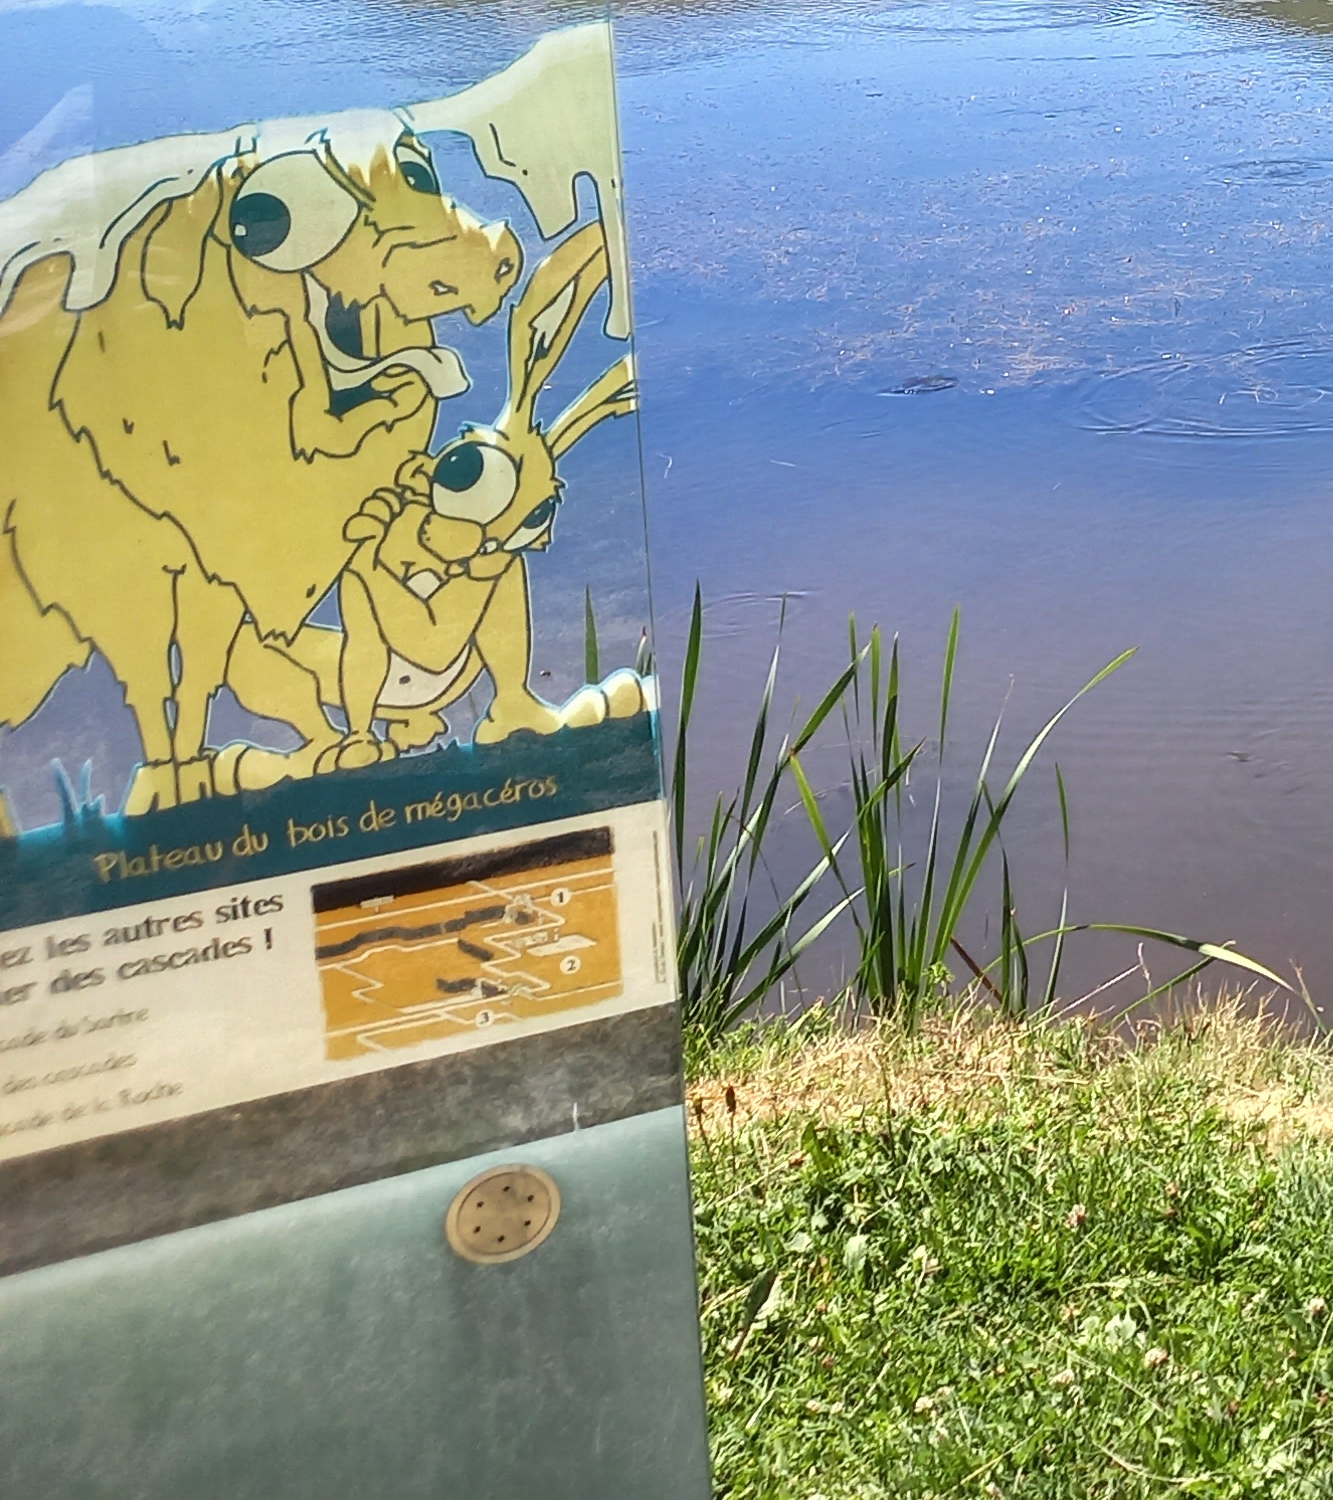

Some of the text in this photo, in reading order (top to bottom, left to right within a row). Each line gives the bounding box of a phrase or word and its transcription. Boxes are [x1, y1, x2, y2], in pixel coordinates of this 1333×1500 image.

[94, 775, 558, 883] Plateau du bois de mégacéros
[45, 935, 91, 960] les
[103, 910, 204, 947] autres
[215, 894, 284, 925] sites
[49, 965, 105, 995] des
[117, 934, 253, 980] cascades
